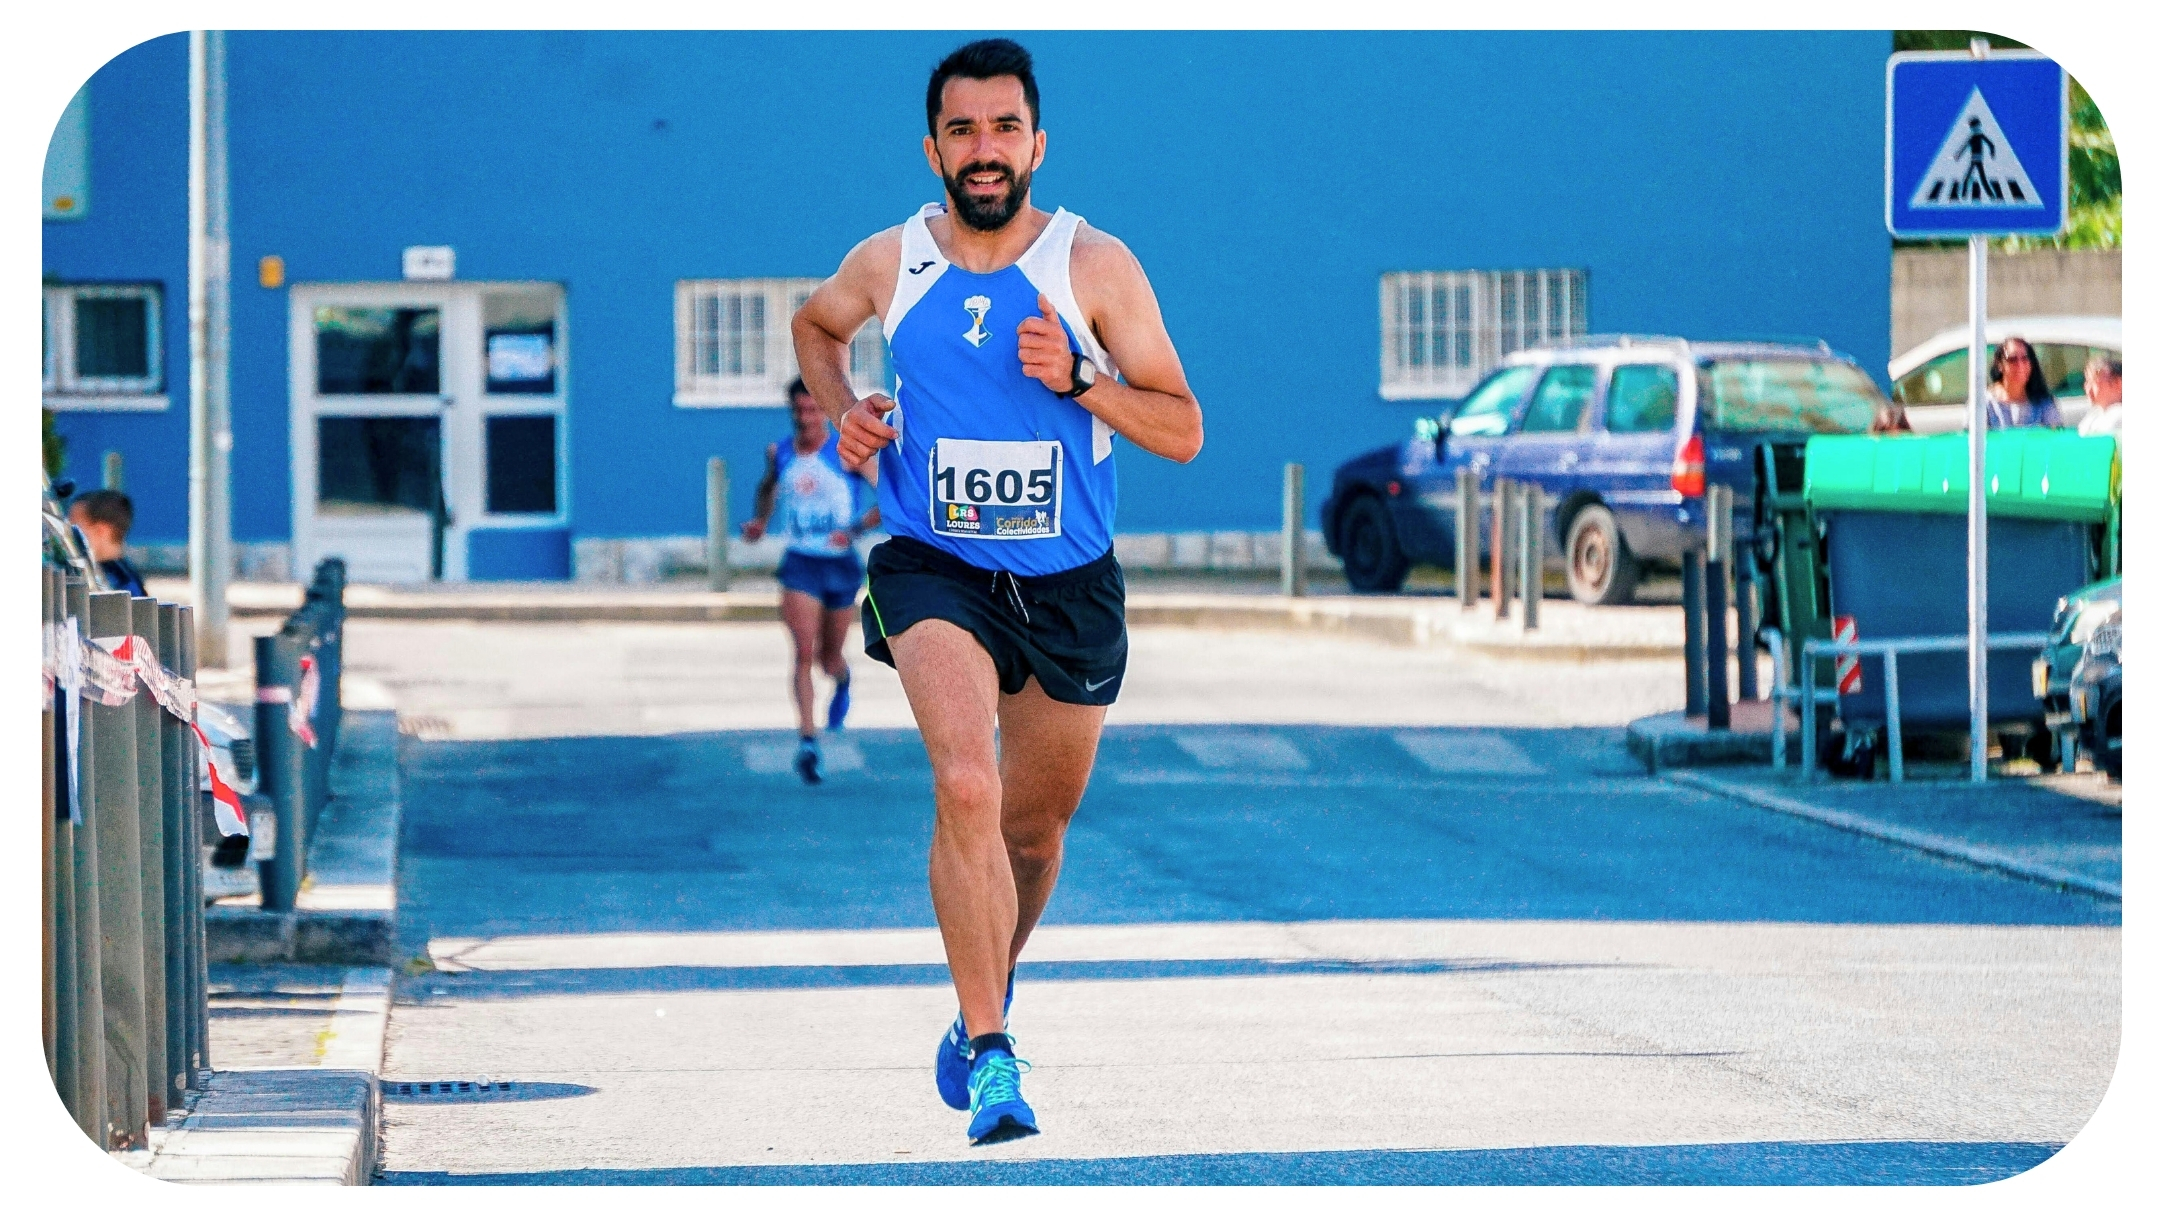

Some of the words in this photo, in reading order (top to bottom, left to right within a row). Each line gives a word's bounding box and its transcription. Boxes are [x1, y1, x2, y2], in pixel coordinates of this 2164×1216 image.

[937, 466, 1053, 504] 1605
[953, 509, 974, 517] LRS
[946, 520, 980, 529] LOURES
[996, 527, 1049, 535] Colectividades
